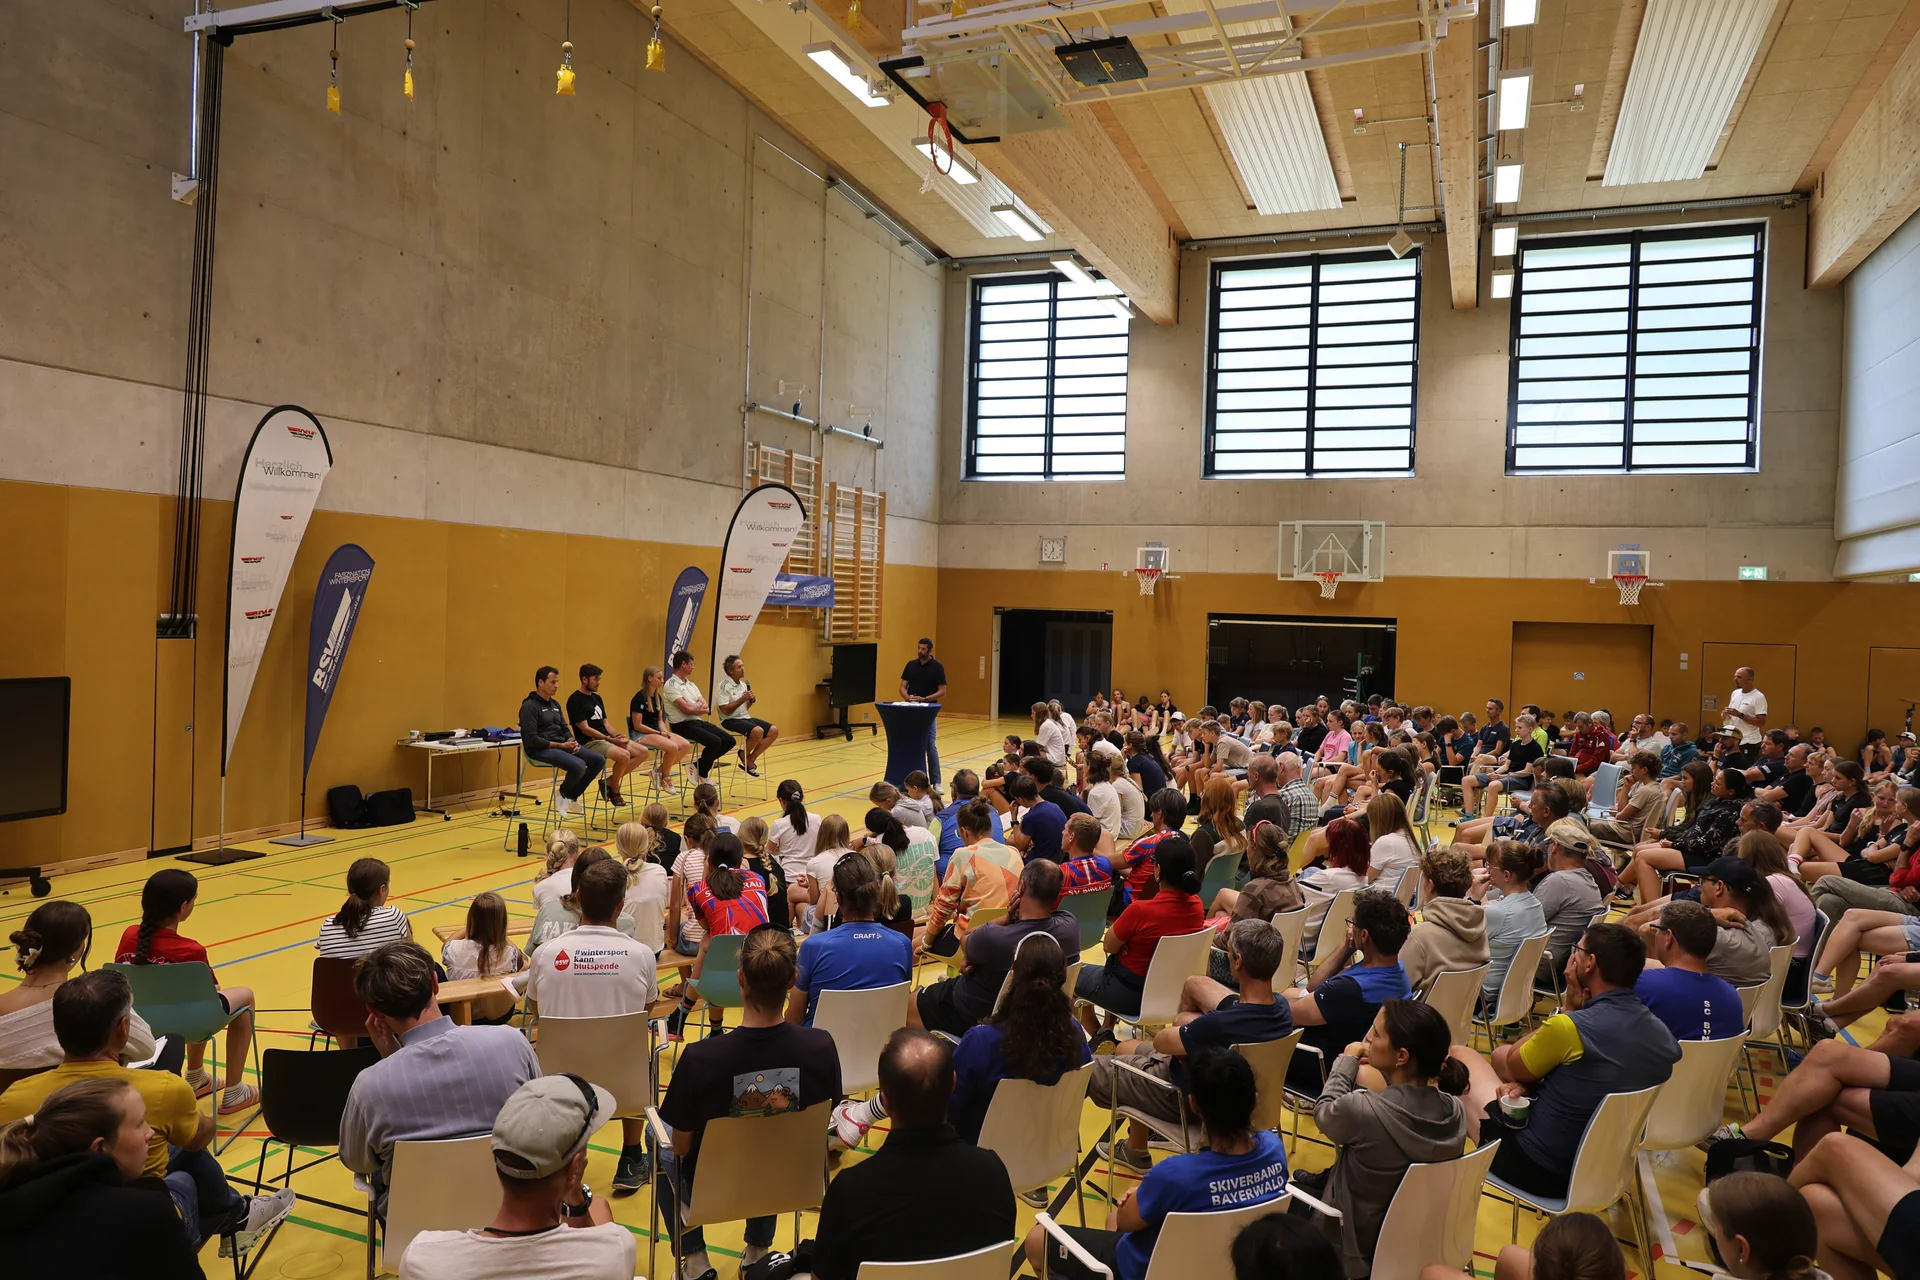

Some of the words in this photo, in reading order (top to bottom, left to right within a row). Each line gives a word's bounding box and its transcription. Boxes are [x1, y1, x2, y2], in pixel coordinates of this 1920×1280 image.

[255, 458, 303, 471] Herzlich
[263, 467, 322, 480] Willkommen!
[746, 523, 797, 532] Willkommen!
[1704, 1001, 1711, 1015] SC
[1209, 1162, 1283, 1193] SKIVERBAND
[1211, 1175, 1284, 1206] BAYERWALD
